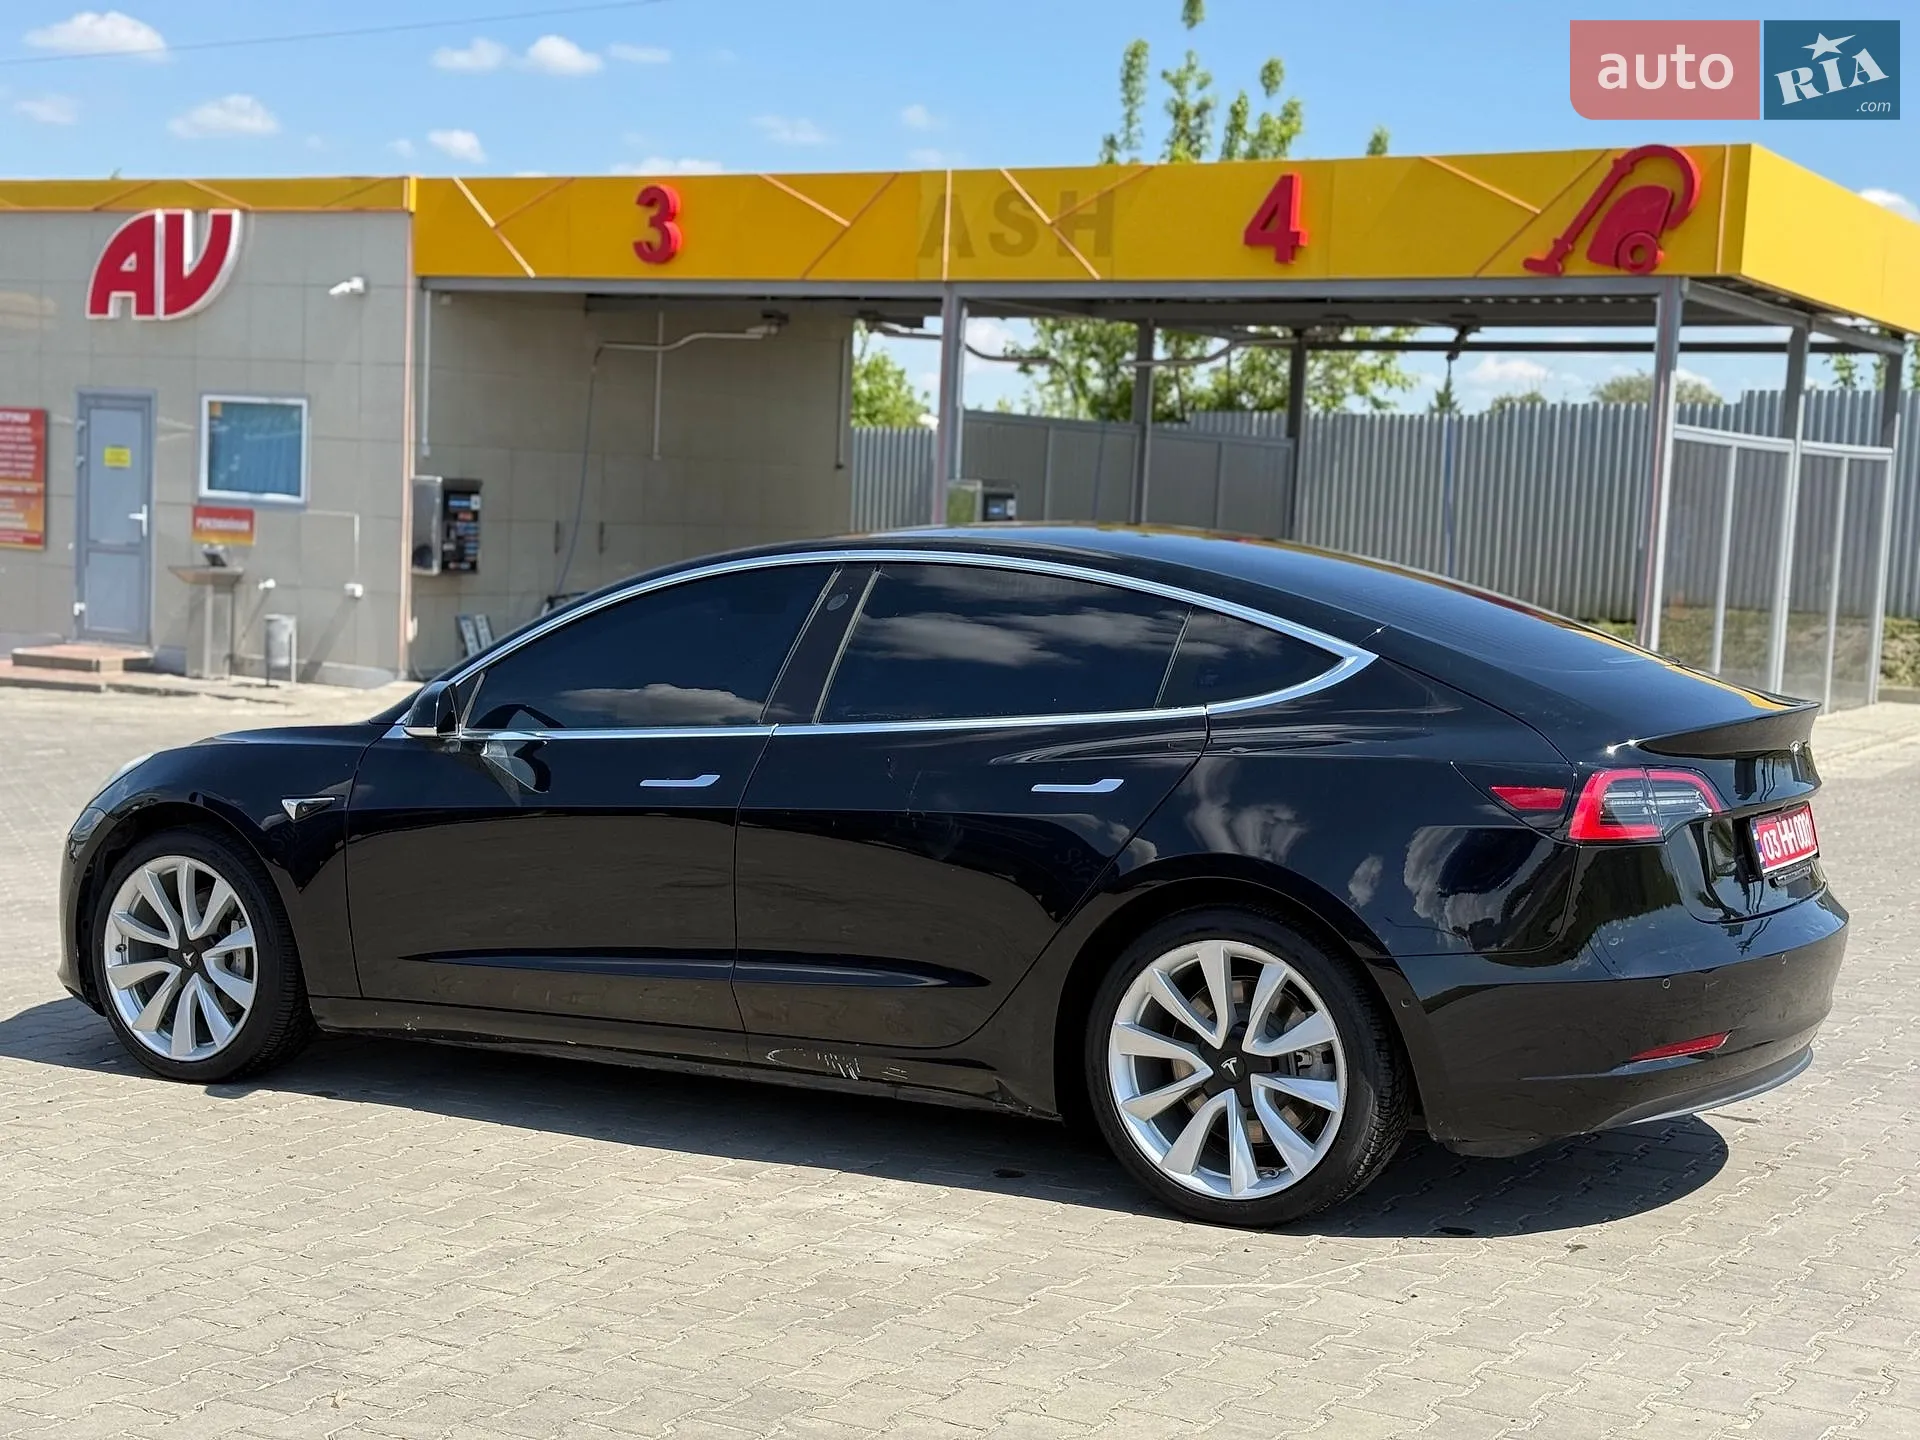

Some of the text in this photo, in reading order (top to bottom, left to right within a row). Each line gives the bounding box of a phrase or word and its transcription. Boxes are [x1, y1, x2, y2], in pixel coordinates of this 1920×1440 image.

[633, 184, 682, 264] 3
[917, 190, 1115, 258] ASH
[1243, 172, 1308, 264] 4
[85, 208, 240, 320] AV
